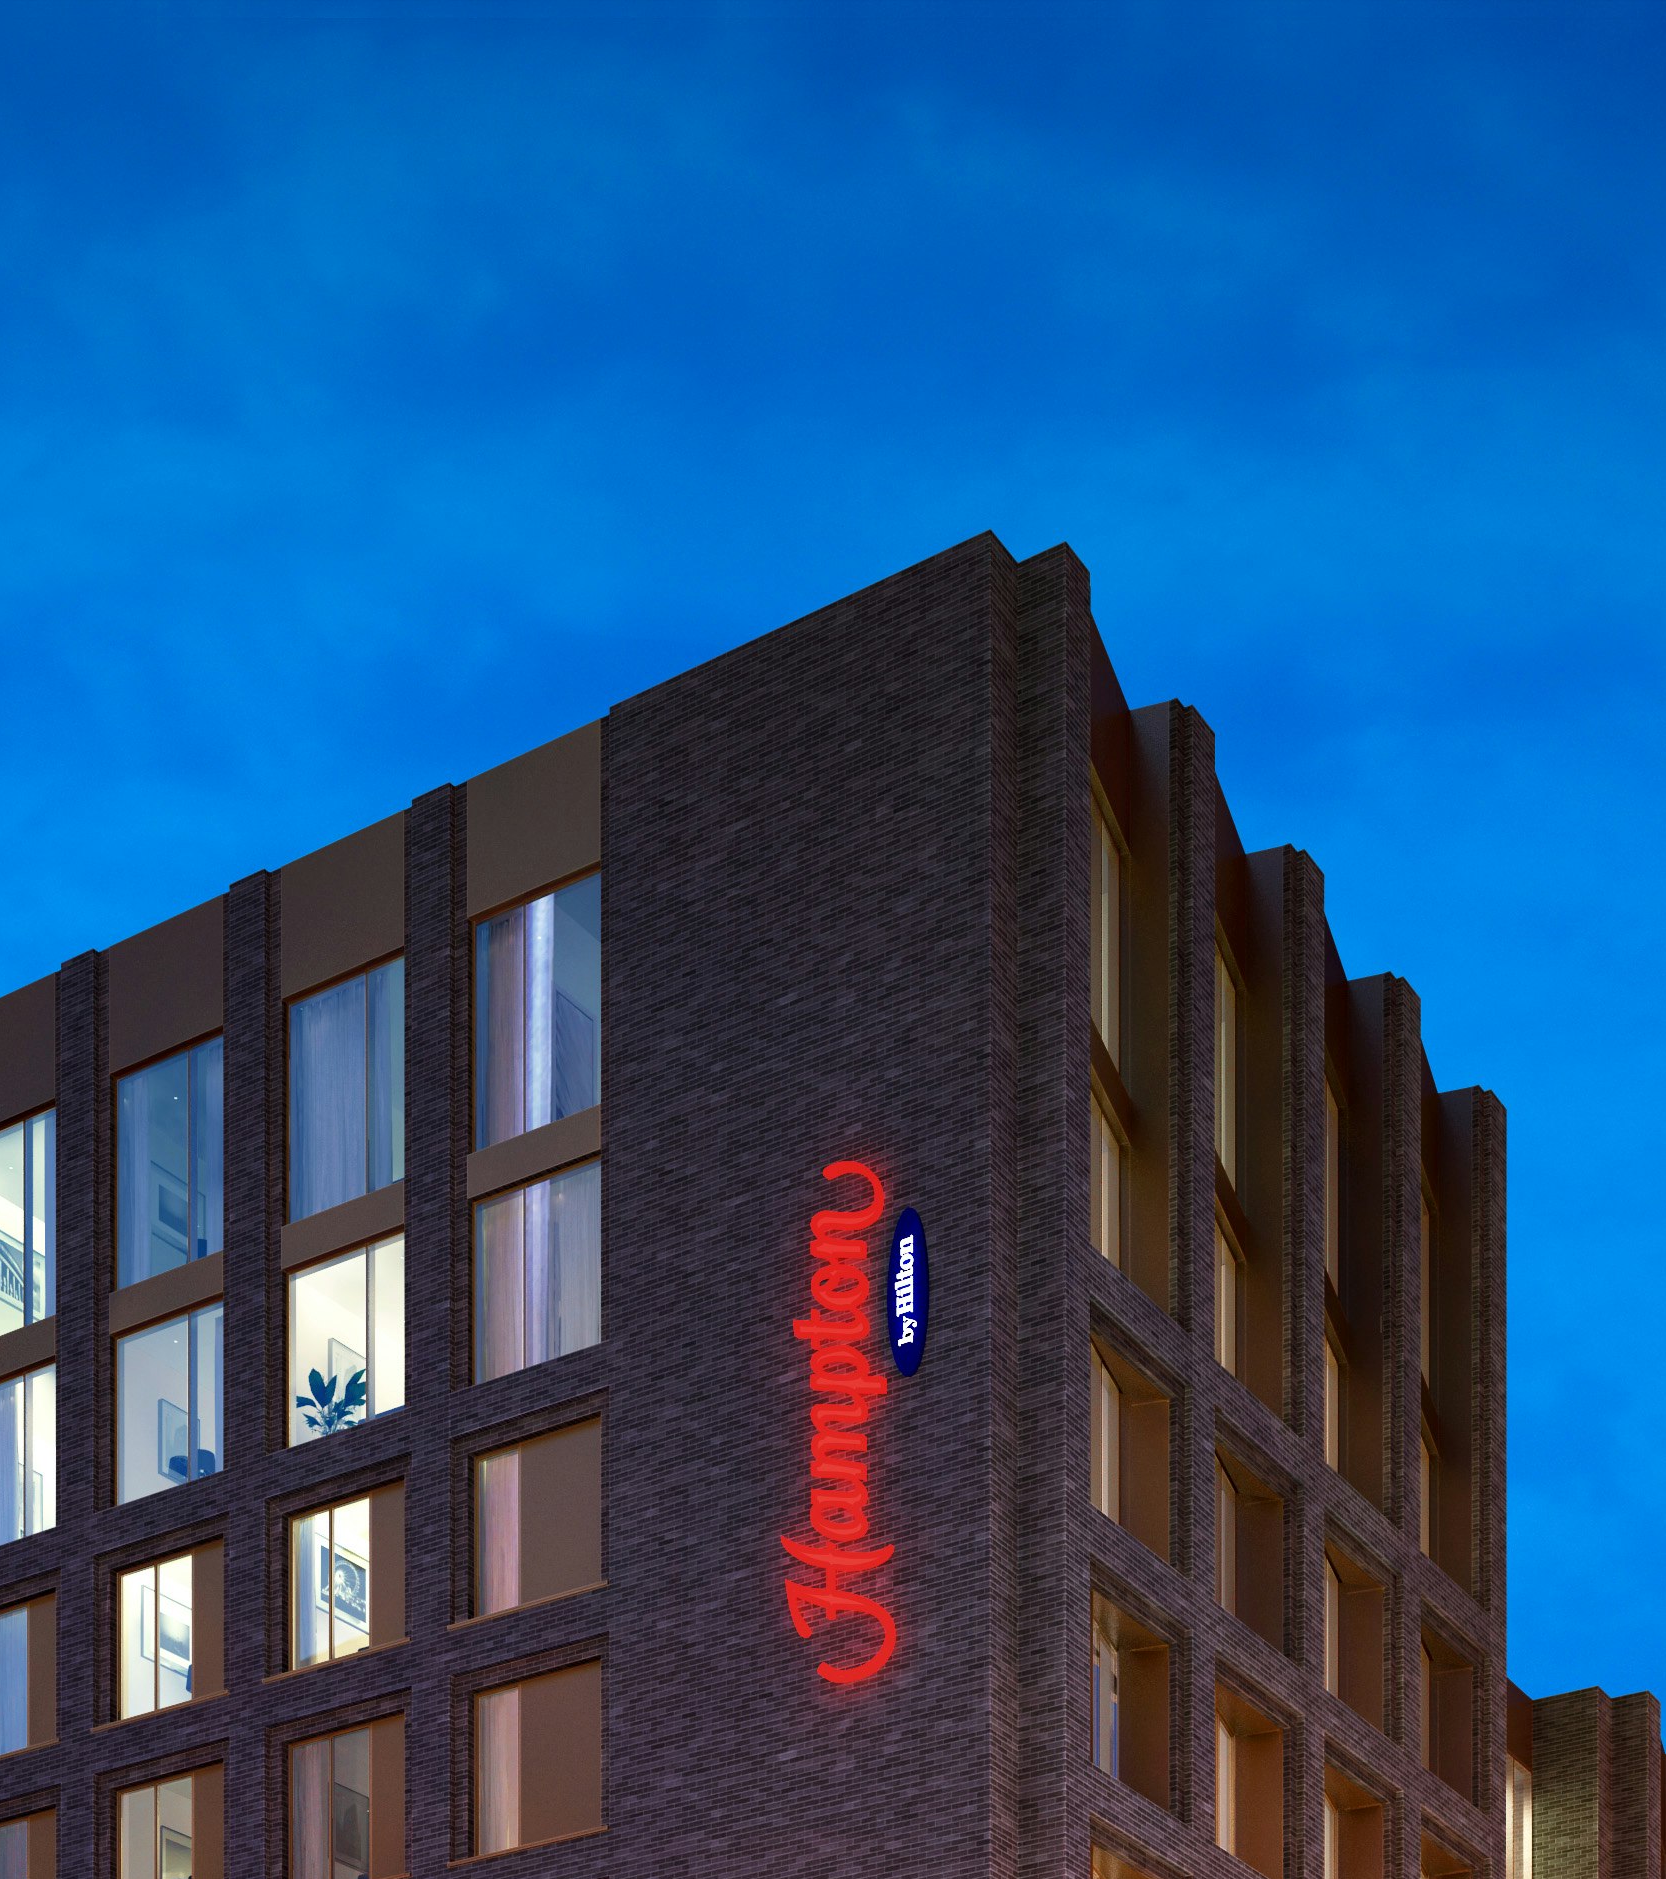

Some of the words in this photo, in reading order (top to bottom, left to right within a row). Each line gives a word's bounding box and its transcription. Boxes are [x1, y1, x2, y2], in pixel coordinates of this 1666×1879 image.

[895, 1235, 914, 1316] Hilton
[897, 1317, 917, 1346] by
[780, 1160, 897, 1683] Hampton
